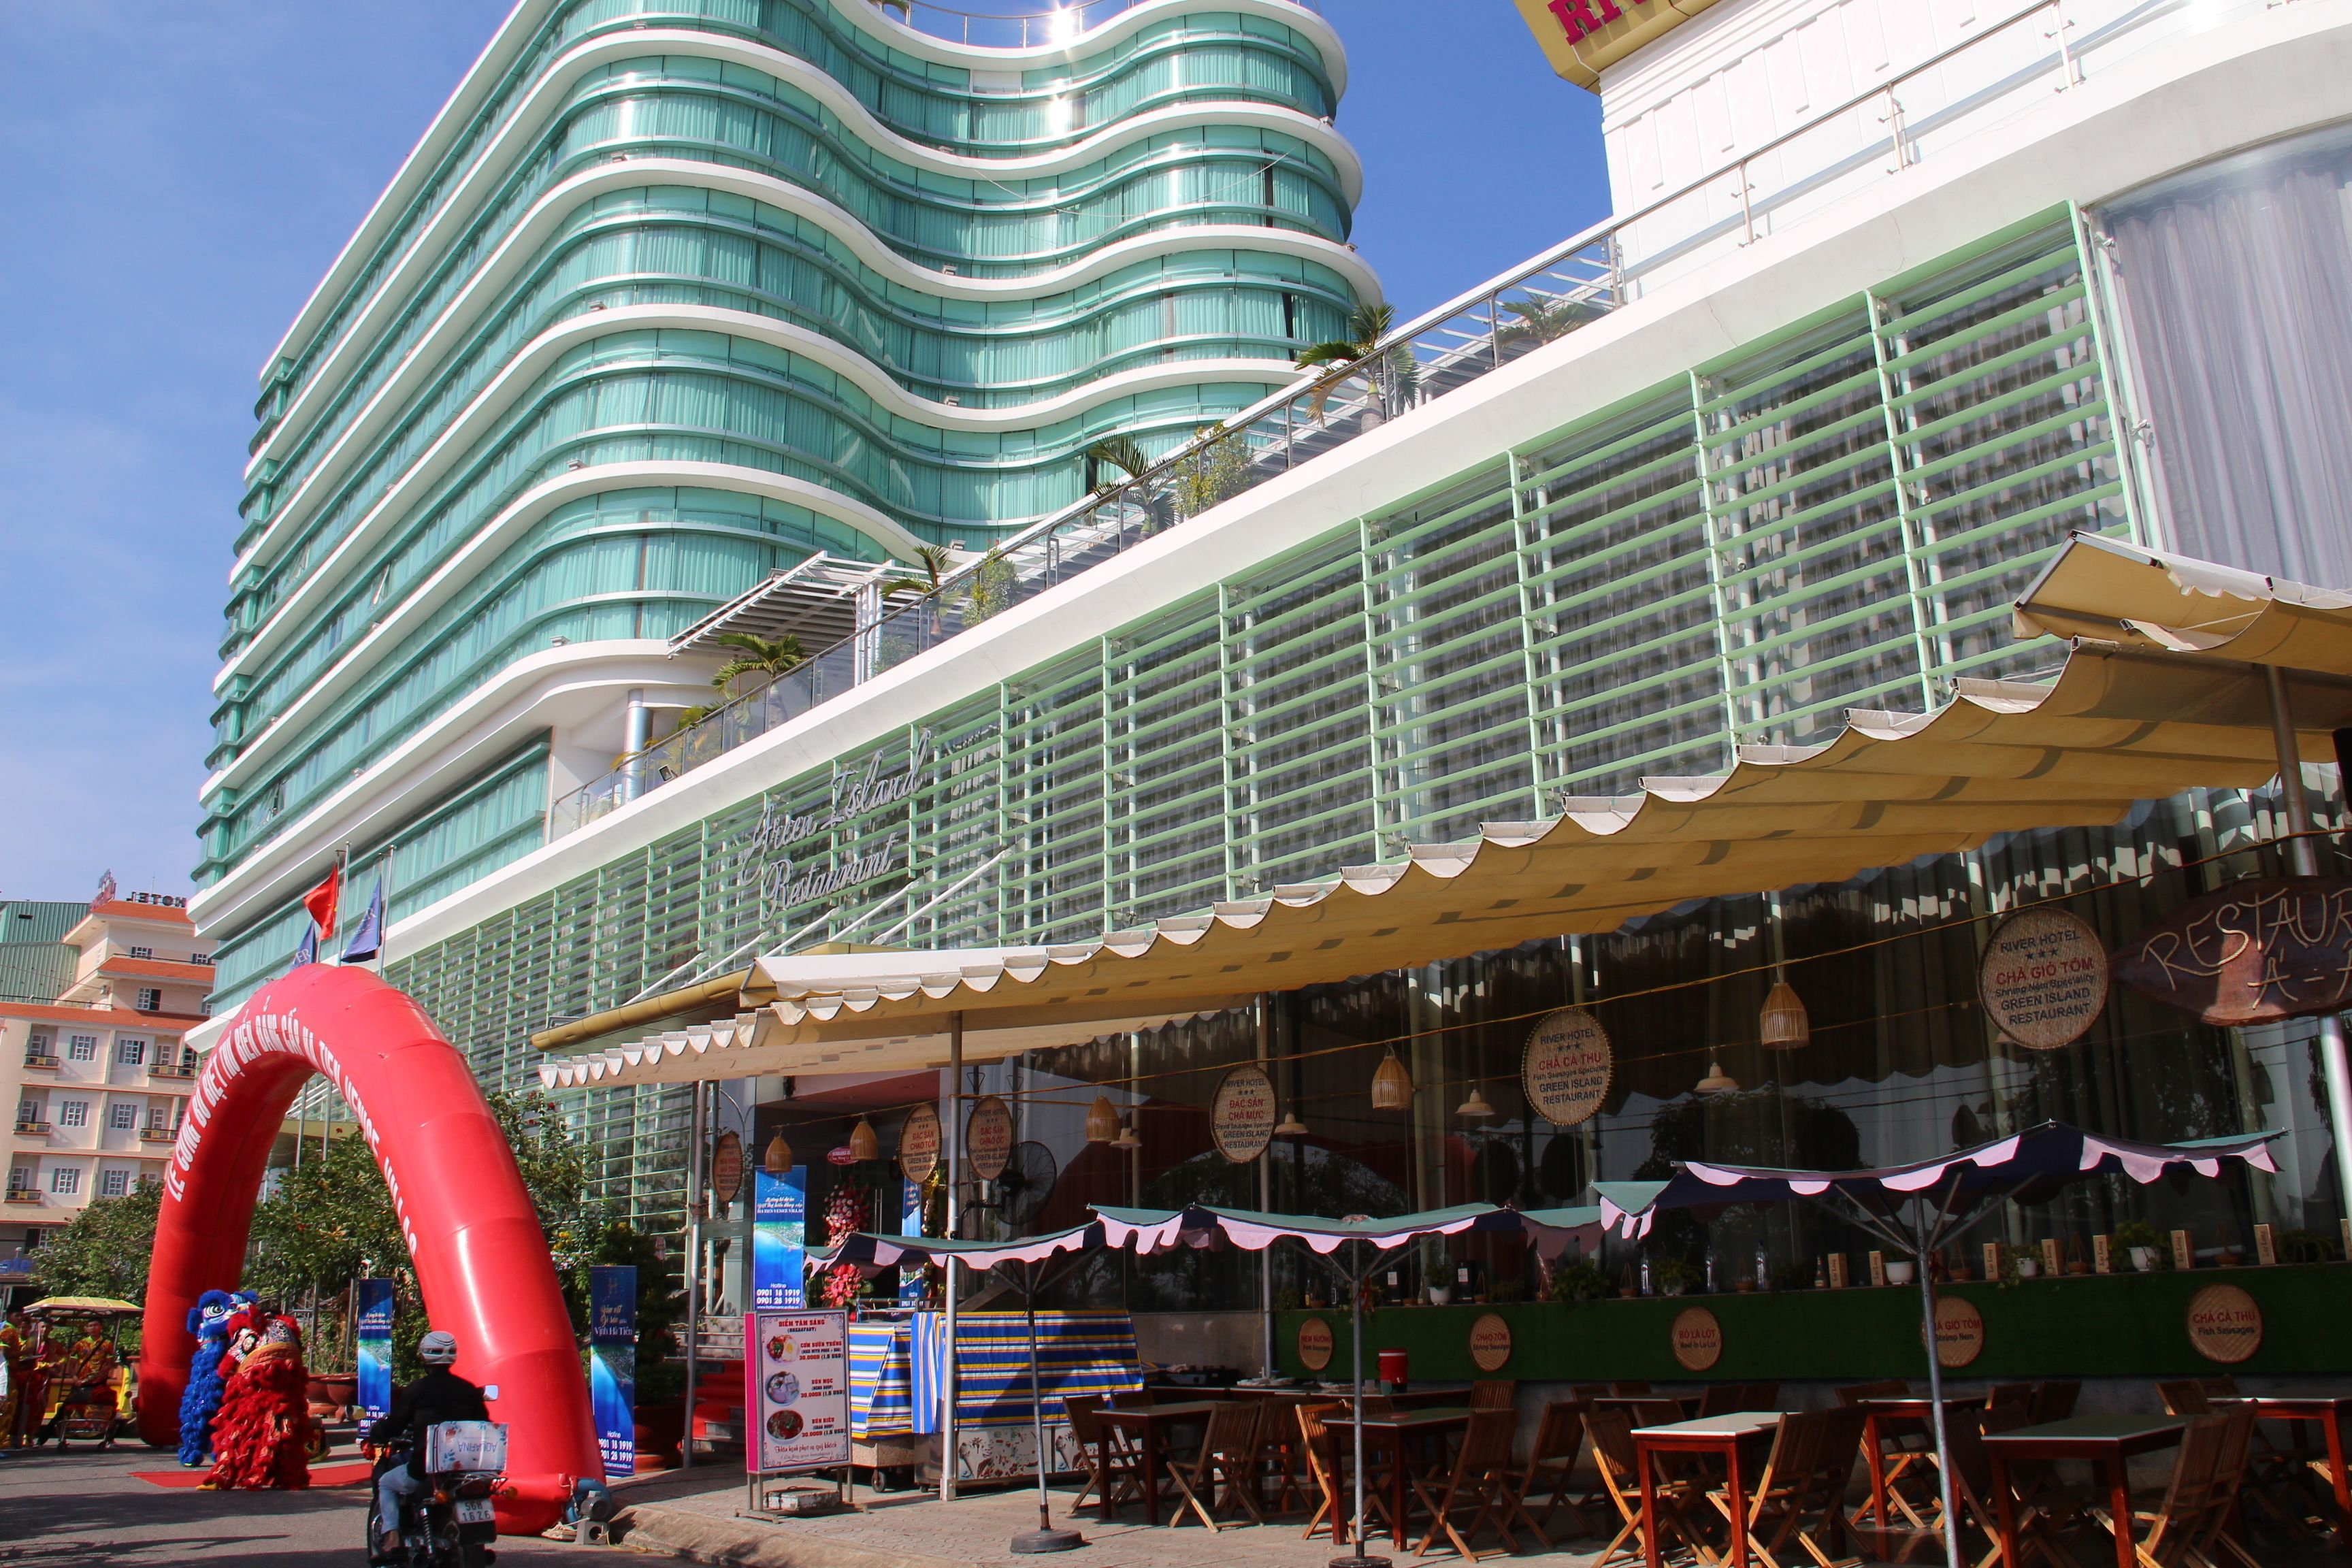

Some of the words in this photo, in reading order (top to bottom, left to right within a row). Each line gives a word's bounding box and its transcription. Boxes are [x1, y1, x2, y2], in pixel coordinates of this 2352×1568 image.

[741, 802, 817, 887] Green
[821, 730, 931, 830] Island
[764, 833, 899, 922] Restaurant
[2001, 937, 2036, 953] RIVER
[2040, 930, 2081, 945] HOTEL
[2141, 887, 2352, 991] RESTAUR
[1995, 987, 2027, 998] Shrimp
[2001, 996, 2042, 1011] GREEN
[2045, 987, 2091, 1003] ISLAND
[2009, 1002, 2091, 1026] RESTAURANT
[1540, 1033, 1565, 1045] RIVER
[1567, 1028, 1596, 1041] HOTEL
[1548, 1070, 1577, 1080] Sausages
[1226, 1079, 1245, 1088] RIVER
[1246, 1078, 1266, 1087] HOTEL
[1539, 1081, 1569, 1093] GREEN
[1571, 1076, 1603, 1088] ISLAND
[1543, 1090, 1601, 1105] RESTAURANT
[1223, 1130, 1246, 1139] GREEN
[1246, 1129, 1269, 1138] ISLAND
[1225, 1140, 1267, 1149] RESTAURANT
[2234, 1310, 2255, 1321] THU
[2198, 1327, 2215, 1335] Fish
[2217, 1326, 2255, 1335] Sausages
[458, 1440, 497, 1452] AQUAFINA
[619, 1440, 633, 1451] 1919
[619, 1451, 633, 1462] 1919
[462, 1510, 491, 1522] 1626
